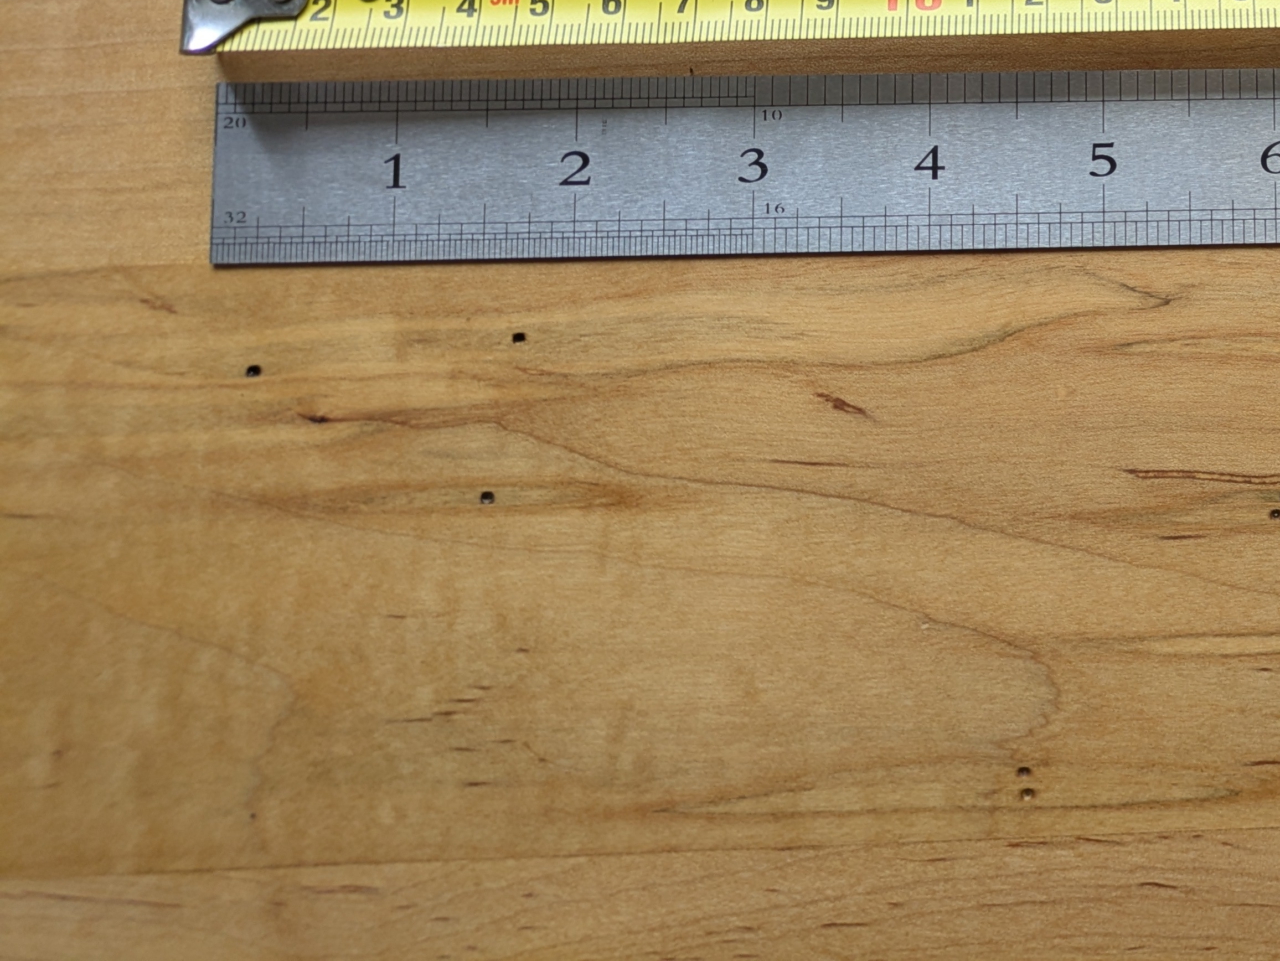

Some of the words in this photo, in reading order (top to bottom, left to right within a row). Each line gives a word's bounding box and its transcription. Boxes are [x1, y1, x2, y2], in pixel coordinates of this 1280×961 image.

[762, 110, 782, 121] 10
[223, 117, 246, 129] 20
[383, 153, 407, 189] 1
[559, 150, 592, 187] 2
[738, 147, 770, 183] 3
[913, 145, 946, 180] 4
[1088, 141, 1118, 177] 5
[765, 203, 785, 214] 16
[224, 211, 247, 223] 32
